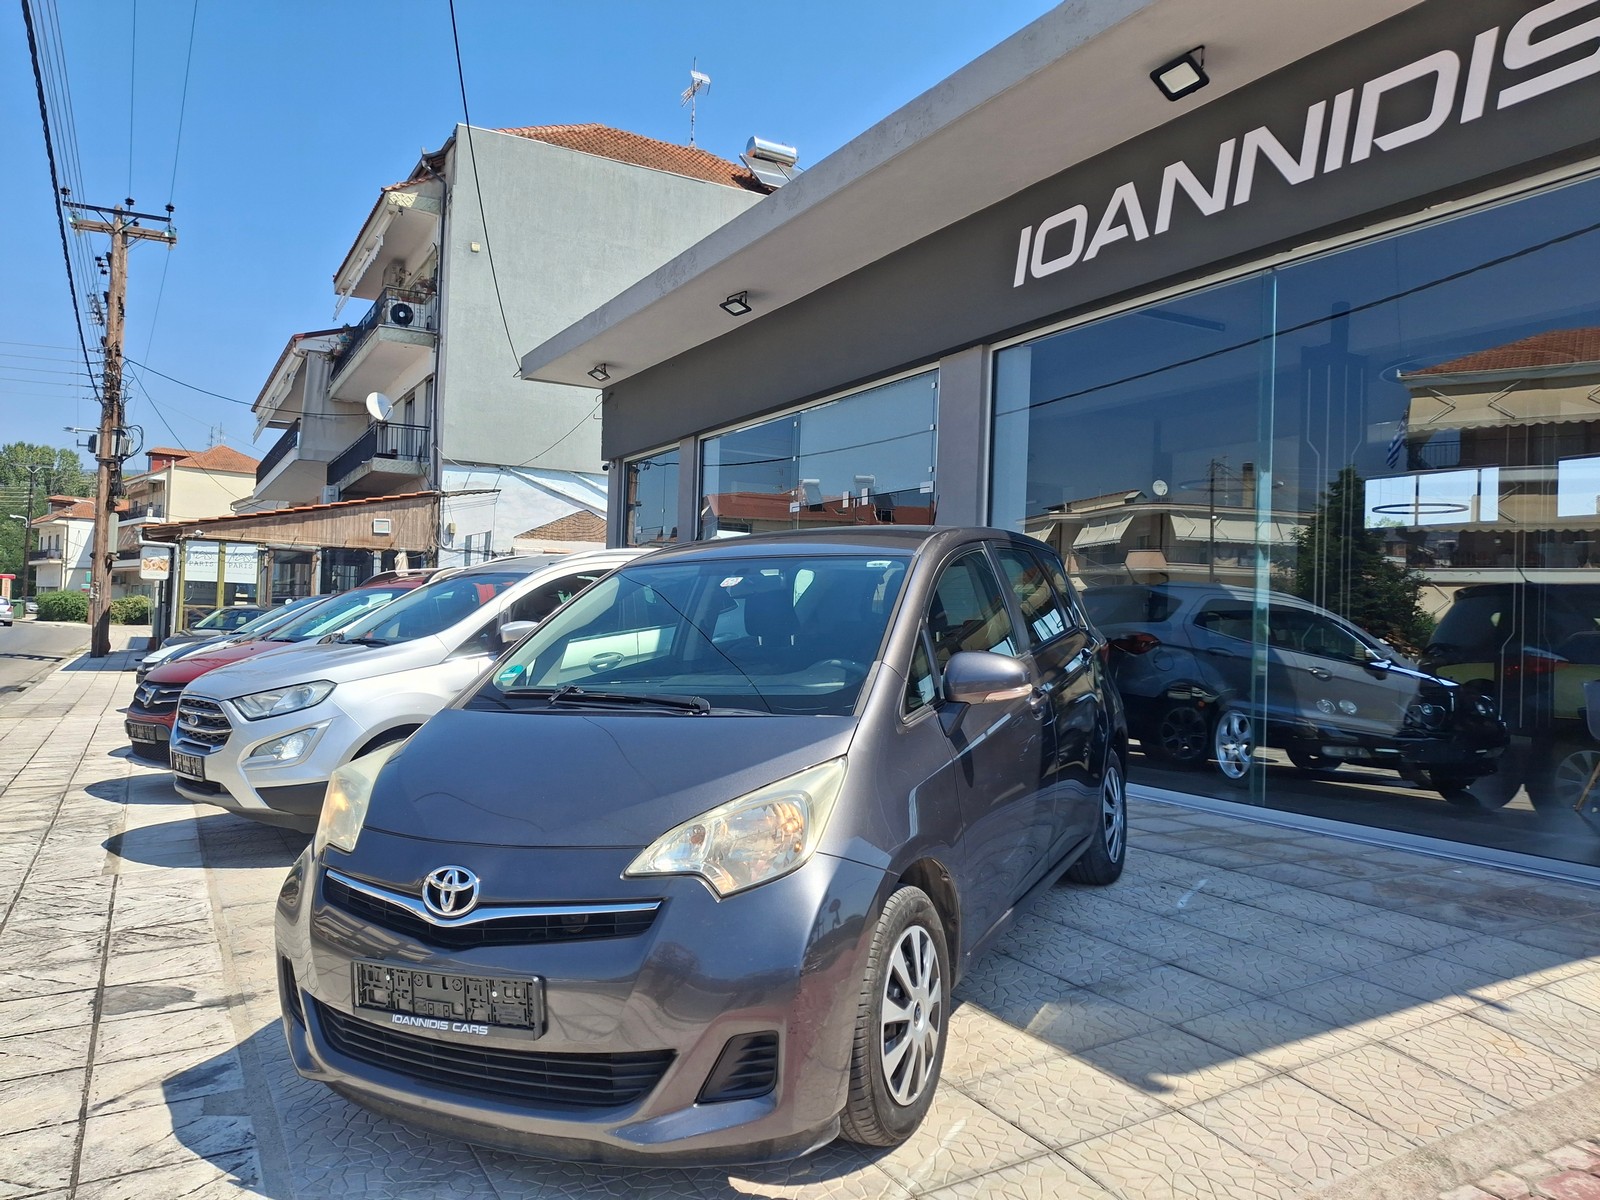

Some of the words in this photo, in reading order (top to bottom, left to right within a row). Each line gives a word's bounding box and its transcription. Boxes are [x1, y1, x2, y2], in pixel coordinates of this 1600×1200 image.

[1013, 0, 1600, 288] IOANNIDIS
[392, 1014, 449, 1031] IOANNIDIS
[452, 1023, 488, 1035] CARS
